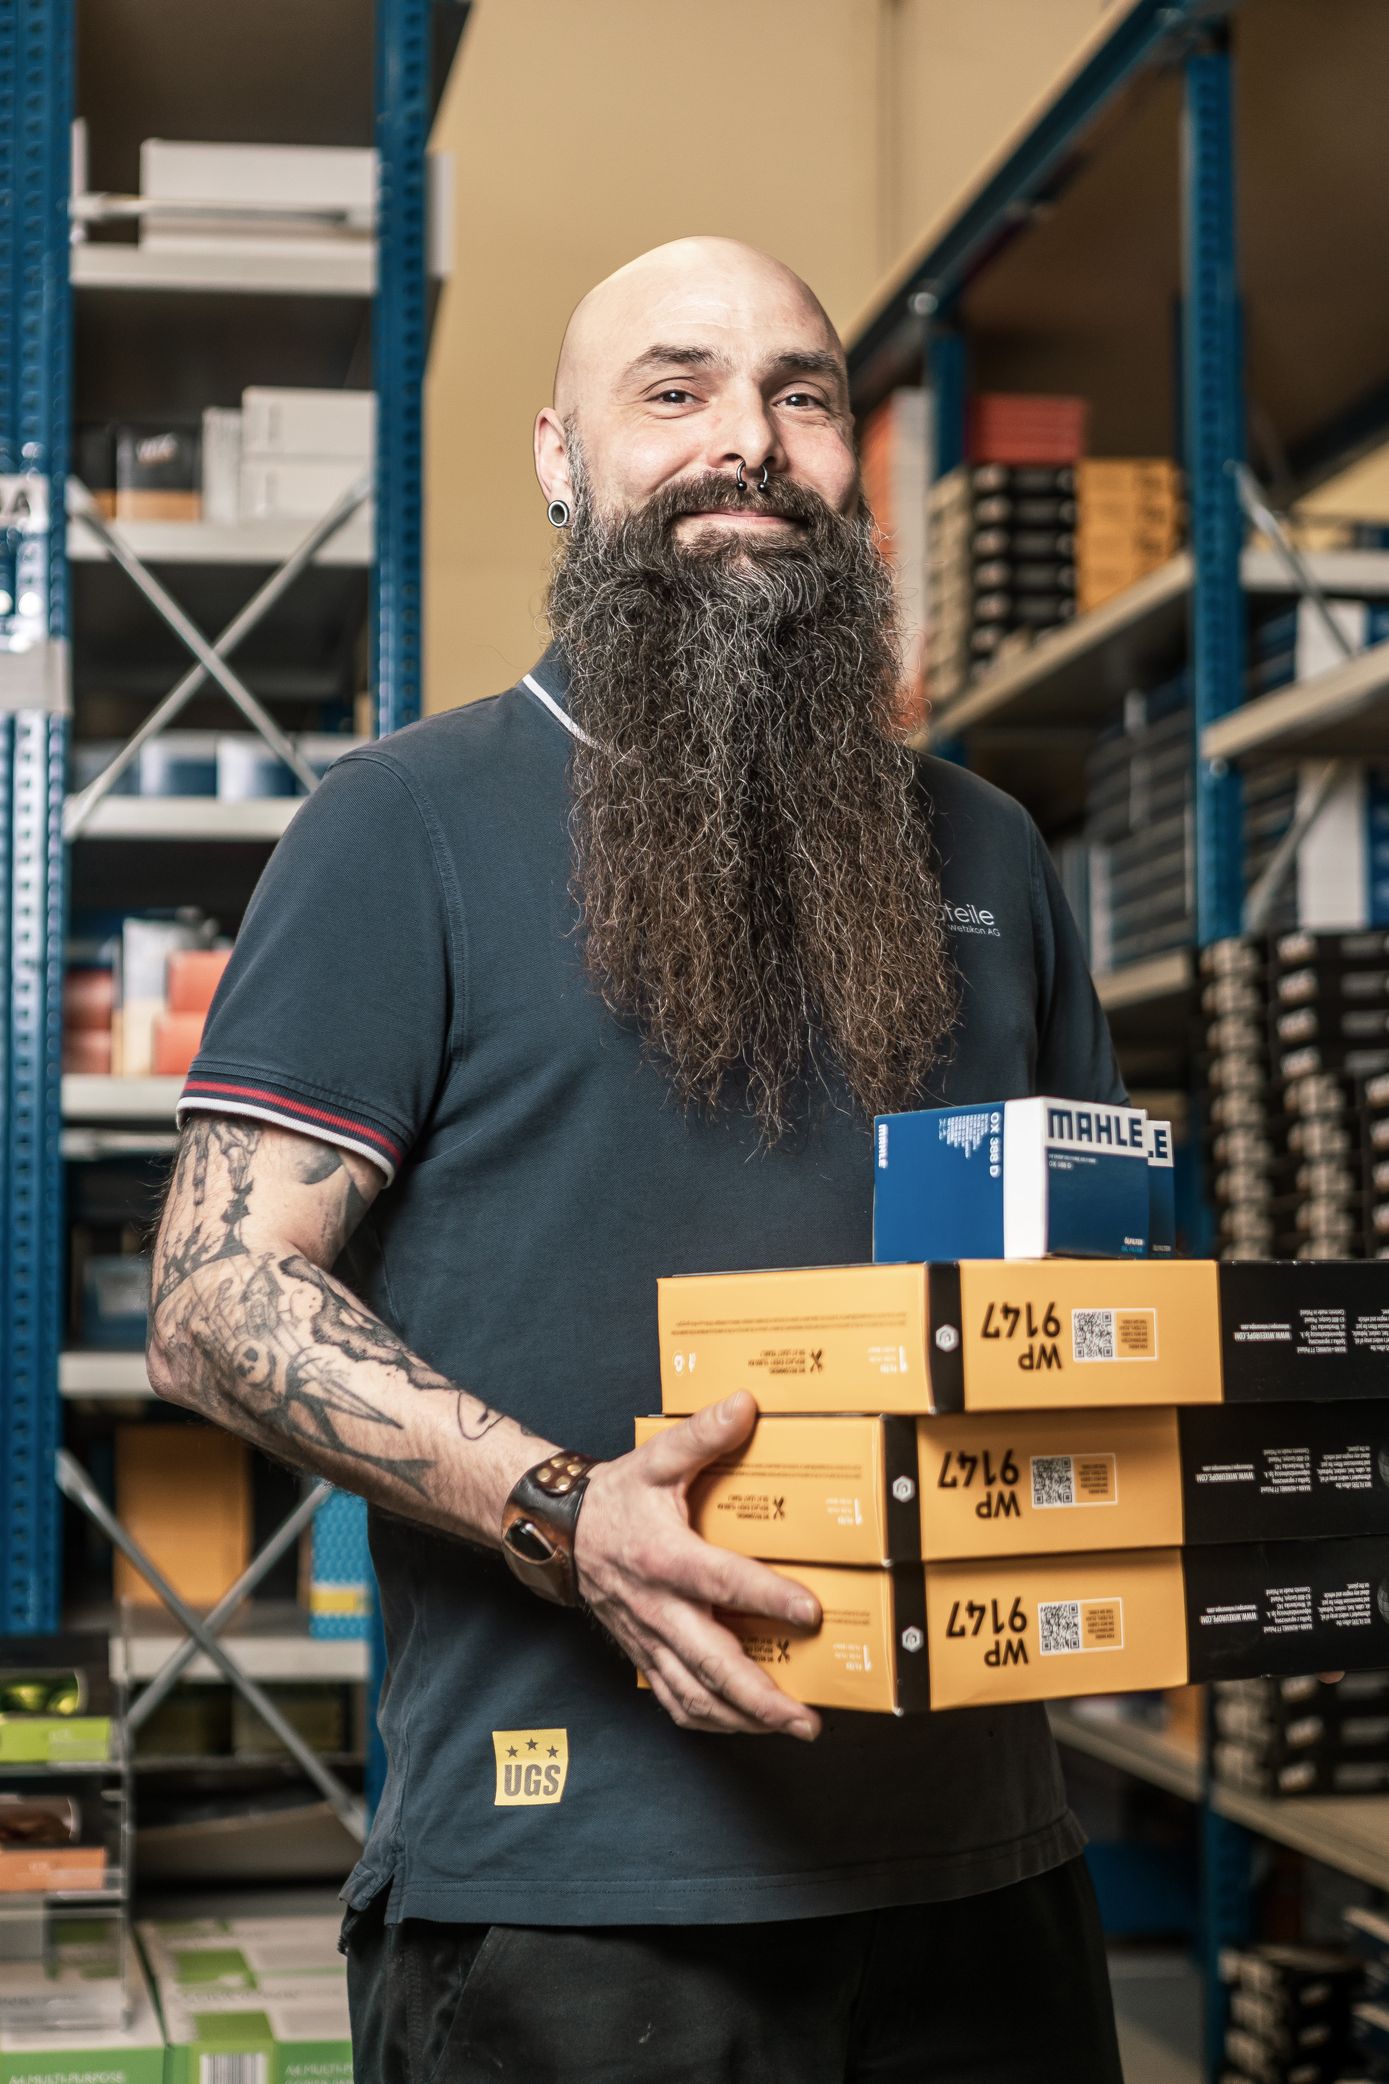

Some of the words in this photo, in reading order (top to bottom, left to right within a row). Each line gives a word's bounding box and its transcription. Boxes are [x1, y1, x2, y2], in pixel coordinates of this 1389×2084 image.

[988, 927, 1001, 937] AG
[990, 1112, 1000, 1134] OX
[1047, 1108, 1143, 1148] MAHLE
[878, 1124, 888, 1168] MAHLE
[989, 1165, 1000, 1178] D
[981, 1301, 1060, 1338] 9147
[1018, 1343, 1062, 1370] WP
[937, 1448, 1019, 1488] 9147
[1196, 1472, 1254, 1482] WWW.WIXEUROPE.COM
[975, 1491, 1021, 1518] WP
[946, 1596, 1027, 1638] 9147
[1200, 1613, 1257, 1624] WWW.WIXEUROPE.COM
[984, 1639, 1029, 1667] WP
[504, 1764, 561, 1796] UGS
